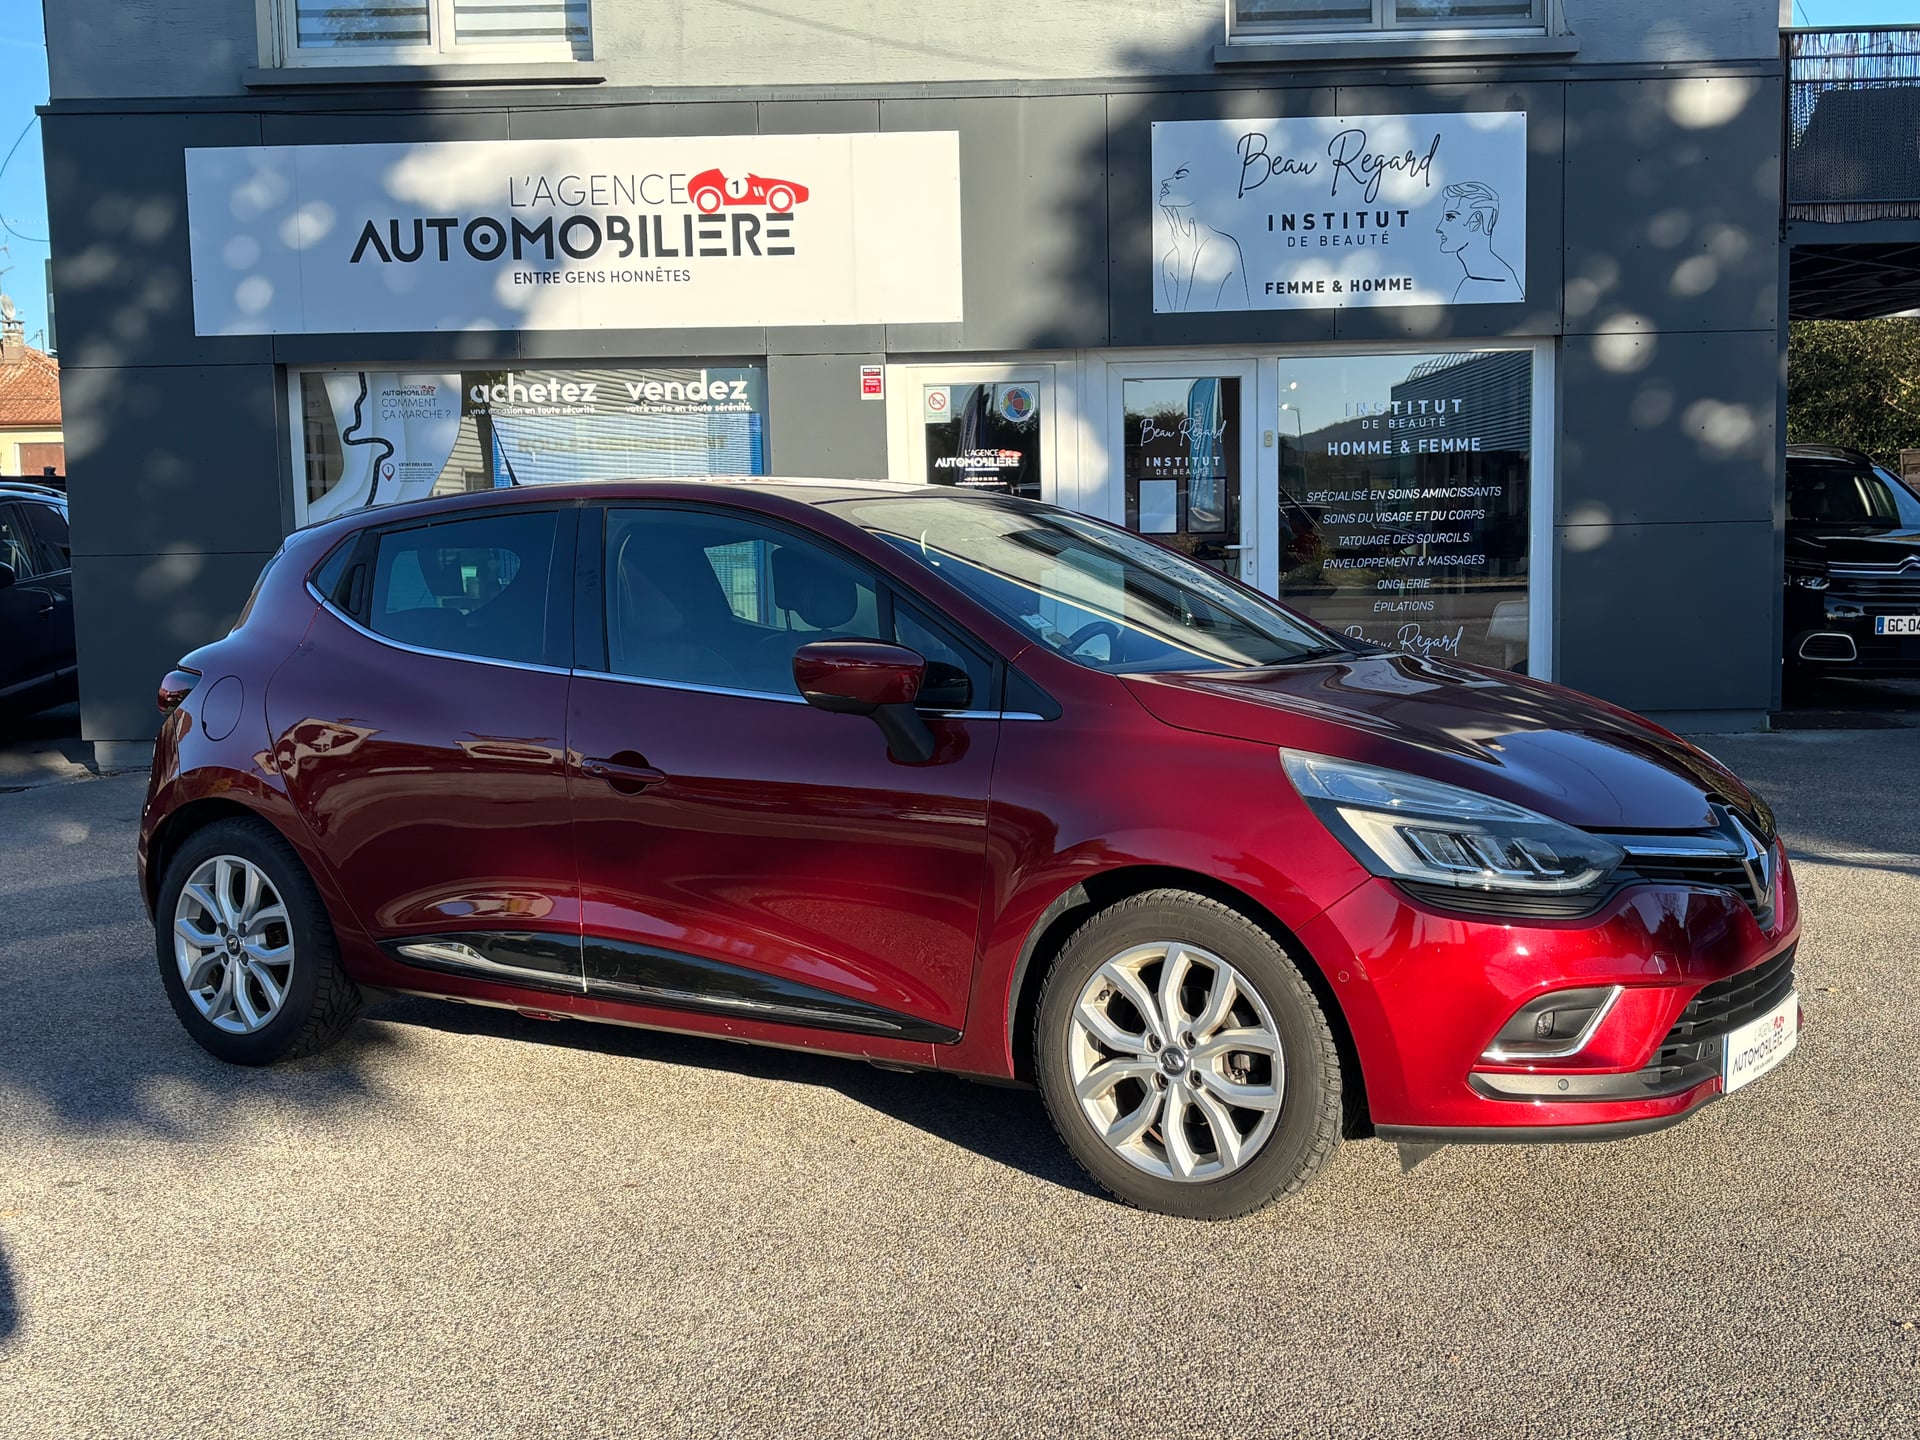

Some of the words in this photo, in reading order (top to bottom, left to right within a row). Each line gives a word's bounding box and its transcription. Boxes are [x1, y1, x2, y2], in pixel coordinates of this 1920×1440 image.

[1237, 132, 1318, 199] Beau
[1328, 129, 1440, 203] Regard
[510, 173, 688, 207] L'AGENCE
[732, 180, 740, 194] 1
[1268, 210, 1409, 231] INSTITUT
[1287, 235, 1308, 247] DE
[1320, 230, 1389, 246] BEAUTÉ
[514, 271, 560, 284] ENTRE
[565, 270, 606, 283] GENS
[610, 266, 691, 283] HONNÊTES
[1265, 280, 1325, 295] FEMME
[1332, 280, 1343, 293] &
[1350, 278, 1413, 292] HOMME
[470, 372, 597, 403] achetez
[625, 369, 747, 400] vendez
[382, 398, 438, 408] COMMENT
[538, 406, 560, 415] toute
[651, 404, 672, 412] auto
[688, 403, 712, 412] toute
[1345, 399, 1462, 417] INSTITUT
[382, 410, 396, 420] ÇA
[399, 410, 442, 419] MARCHE
[446, 410, 451, 419] ?
[1362, 420, 1379, 430] DE
[1388, 416, 1446, 429] BEAUTÉ
[1140, 418, 1175, 446] Beau
[1178, 417, 1227, 449] Regard
[1327, 441, 1392, 456] HOMME
[1400, 440, 1410, 454] &
[1418, 437, 1481, 453] FEMME
[1146, 456, 1220, 467] INSTITUT
[1306, 488, 1368, 502] SPÉCIALISÉ
[1370, 489, 1386, 500] EN
[1387, 488, 1420, 500] SOINS
[1421, 486, 1502, 498] AMINCISSANTS
[1322, 513, 1355, 524] SOINS
[1358, 512, 1374, 523] DU
[1375, 511, 1413, 522] VISAGE
[1415, 510, 1429, 521] ET
[1430, 510, 1447, 521] DU
[1448, 509, 1486, 520] CORPS
[1338, 534, 1390, 546] TATOUAGE
[1393, 534, 1414, 544] DES
[1416, 532, 1470, 543] SOURCILS
[1323, 556, 1416, 569] ENVELOPPEMENT
[1417, 556, 1424, 566] &
[1427, 554, 1485, 566] MASSAGES
[1377, 578, 1431, 590] ONGLERIE
[1373, 600, 1435, 612] ÉPILATIONS
[1397, 623, 1464, 656] Regard
